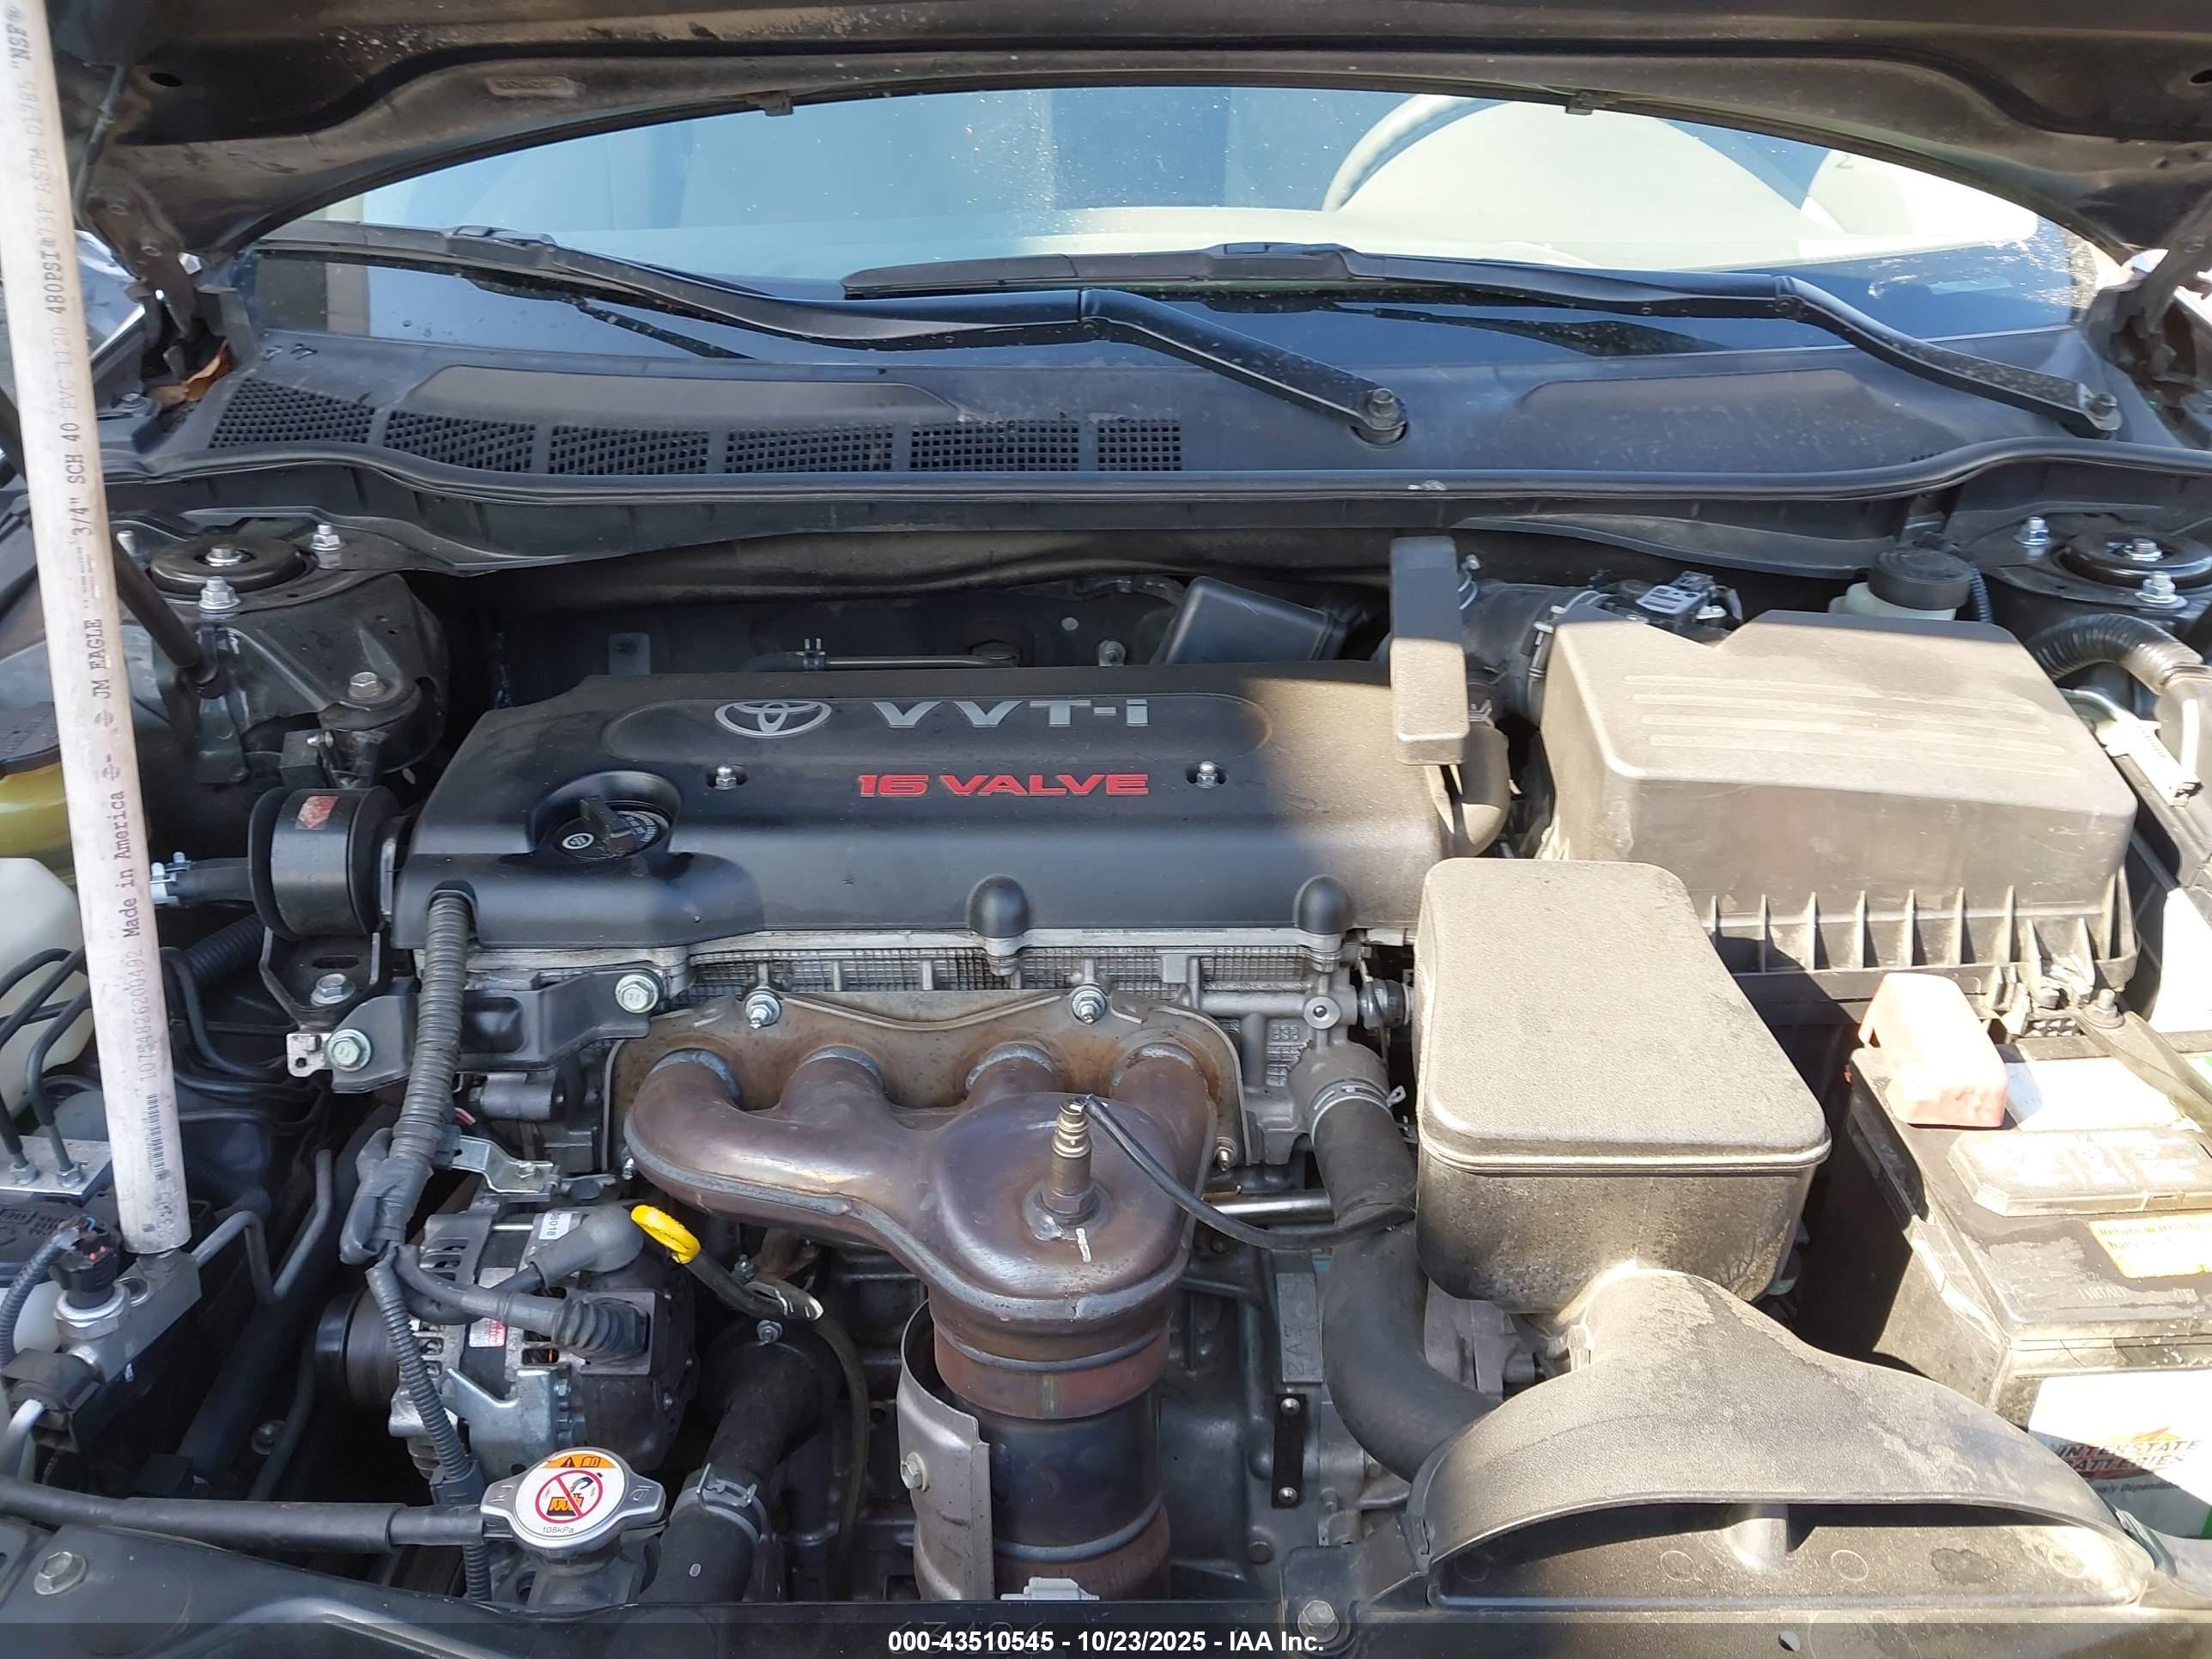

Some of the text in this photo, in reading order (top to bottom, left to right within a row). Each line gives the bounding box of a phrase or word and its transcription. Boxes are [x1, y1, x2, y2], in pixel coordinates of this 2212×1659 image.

[27, 147, 52, 193] ASTM
[51, 326, 70, 365] 1120
[58, 379, 76, 410] PVC
[59, 422, 81, 441] 40
[64, 453, 86, 484] SCH
[69, 497, 93, 536] 3/4"
[84, 618, 107, 670] EAGLE
[90, 678, 111, 699] JM
[872, 699, 1148, 728] VVT-i
[859, 774, 1149, 797] 16 VALVE
[108, 791, 131, 859] America
[115, 867, 134, 887] in
[118, 897, 140, 939] Made
[542, 1525, 574, 1534] 108kPa
